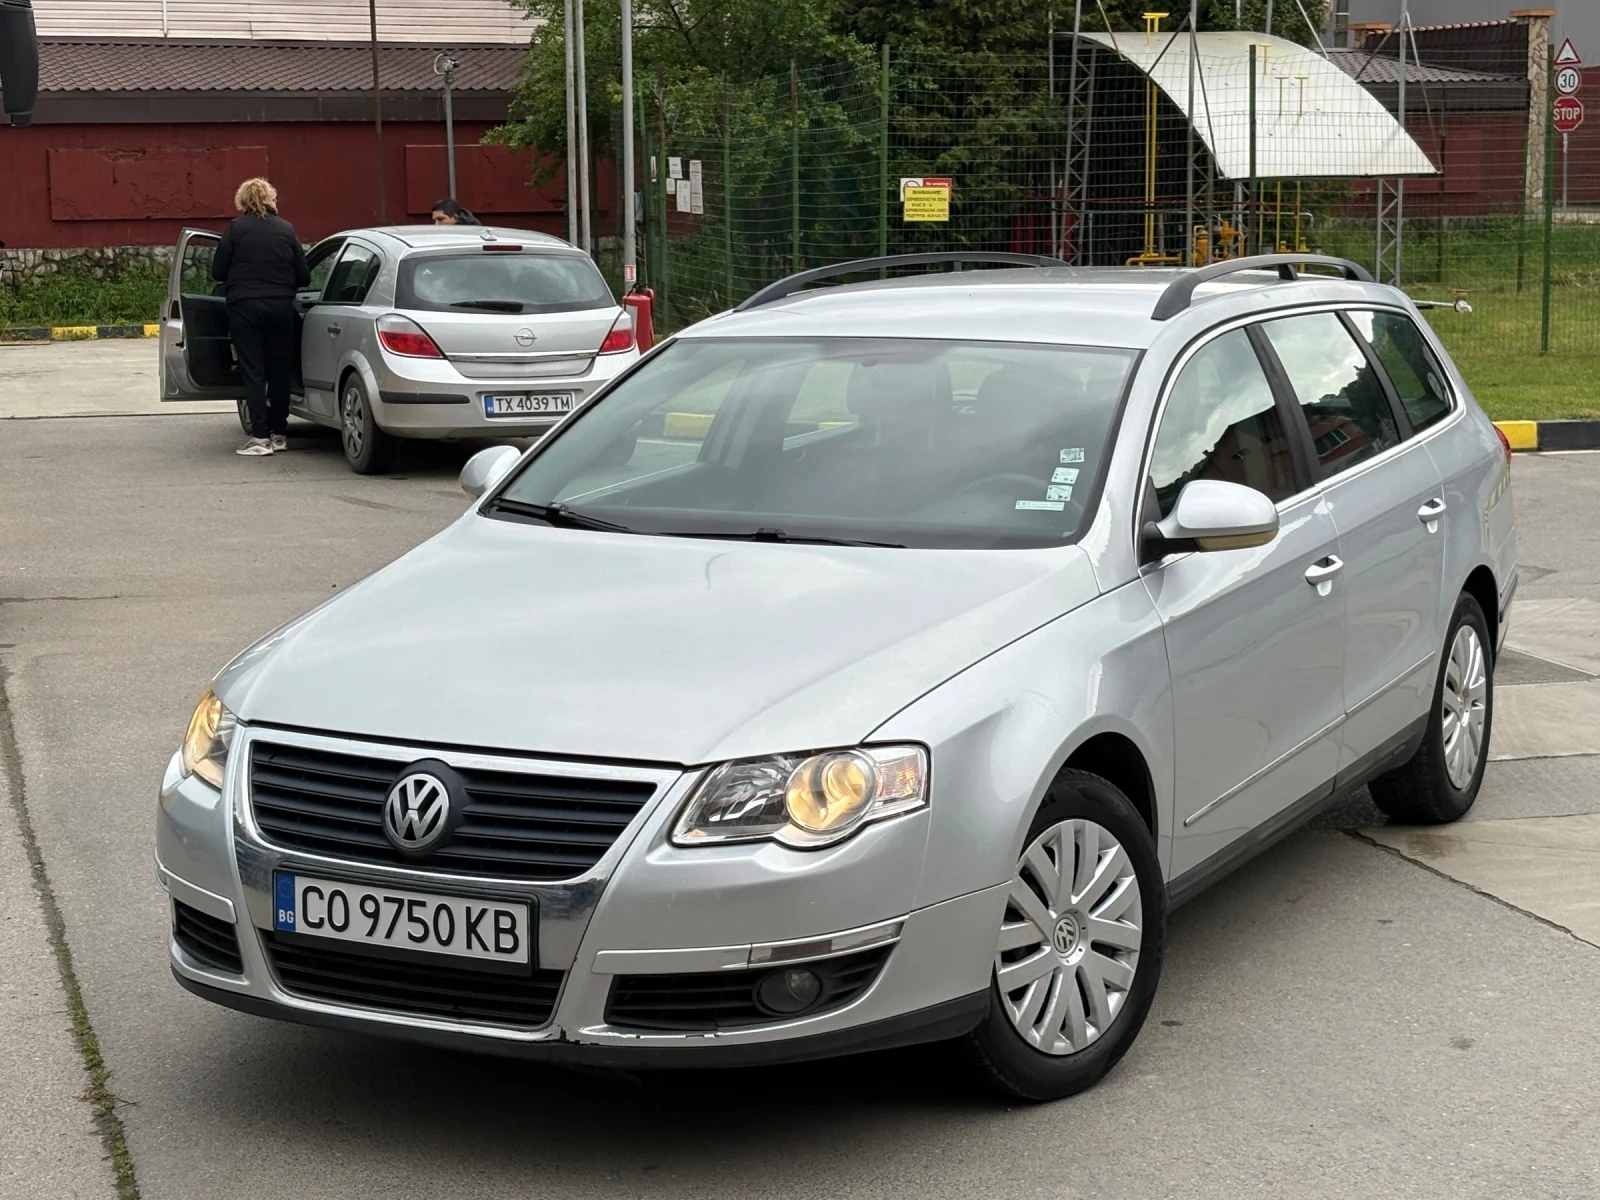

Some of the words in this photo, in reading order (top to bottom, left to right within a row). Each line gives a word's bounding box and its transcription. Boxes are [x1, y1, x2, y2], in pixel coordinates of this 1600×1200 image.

[1560, 73, 1576, 88] 30
[1553, 107, 1580, 121] STOP
[496, 397, 514, 412] TX
[516, 397, 550, 411] 4039
[552, 396, 570, 410] TM
[385, 773, 450, 849] VW
[278, 909, 295, 924] BG
[302, 885, 350, 933] CO
[359, 893, 455, 947] 9750
[465, 906, 519, 954] KB
